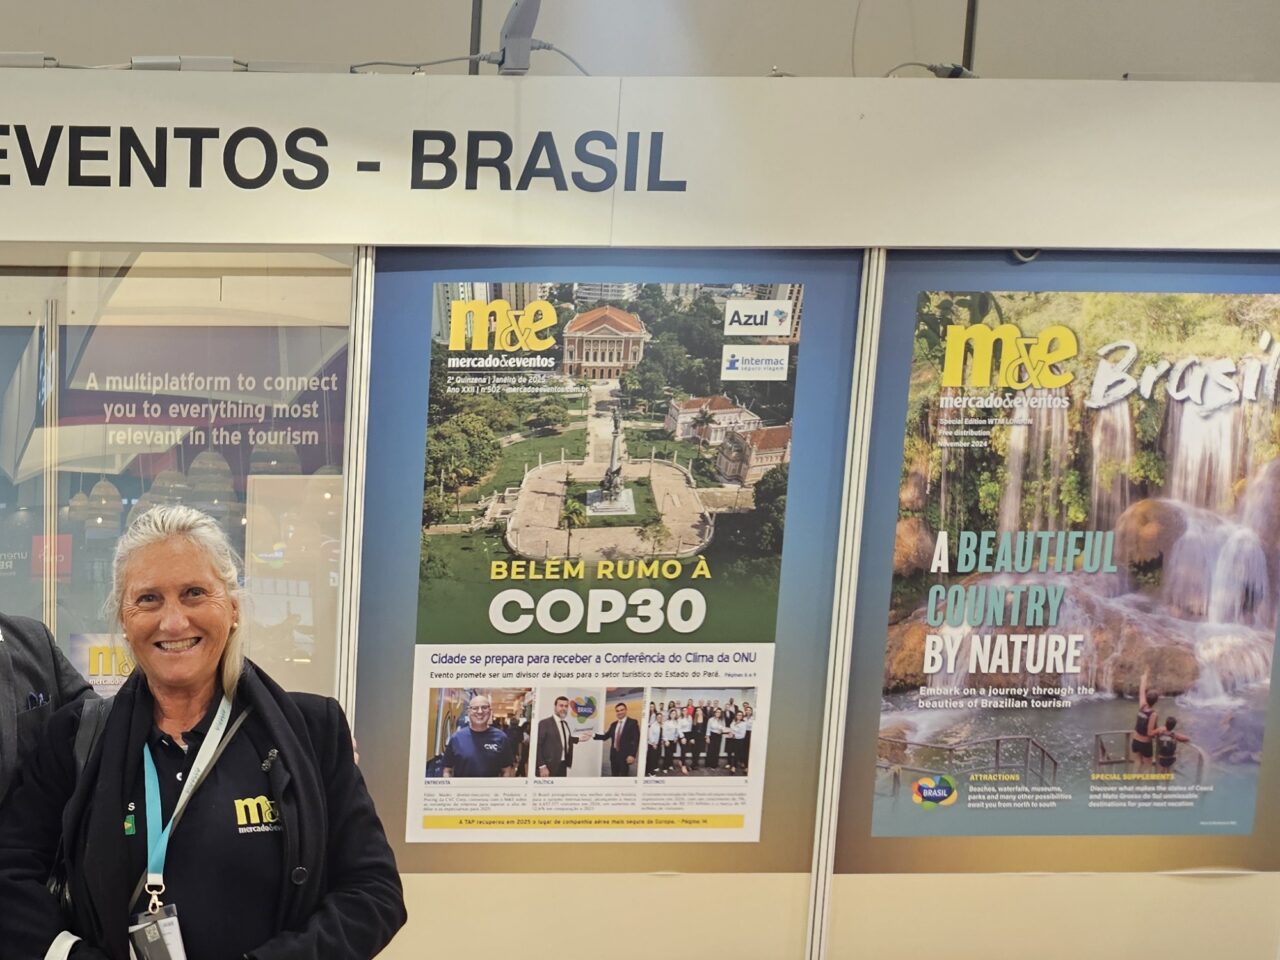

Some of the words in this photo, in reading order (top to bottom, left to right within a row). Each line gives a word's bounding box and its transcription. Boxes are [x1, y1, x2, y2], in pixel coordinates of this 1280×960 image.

[411, 130, 687, 192] BRASIL
[448, 298, 557, 352] m&e
[729, 310, 768, 326] Azul
[448, 354, 555, 368] mercado&eventos
[741, 357, 784, 365] Intermac
[942, 323, 1078, 391] m&e
[86, 373, 98, 390] A
[106, 372, 230, 395] multiplatform
[237, 374, 256, 390] to
[264, 374, 338, 391] connect
[104, 403, 136, 422] you
[144, 401, 162, 417] to
[169, 400, 265, 423] everything
[273, 402, 318, 417] most
[940, 393, 1070, 408] mercado&eventos
[108, 429, 182, 445] relevant
[190, 429, 205, 444] in
[212, 429, 241, 445] the
[248, 429, 318, 445] tourism
[930, 530, 949, 573] A
[957, 530, 1118, 573] BEAUTIFUL
[490, 556, 584, 580] BELÉM
[597, 559, 682, 579] RUMO
[691, 555, 712, 579] À
[488, 588, 707, 634] COP30
[926, 584, 1065, 628] COUNTRY
[431, 653, 466, 664] Cidade
[470, 656, 481, 664] se
[484, 655, 524, 666] prepara
[527, 655, 549, 666] para
[553, 654, 592, 664] receber
[595, 655, 601, 663] a
[605, 652, 665, 663] Conferência
[669, 653, 682, 663] do
[685, 652, 714, 663] Clima
[717, 653, 729, 662] da
[733, 652, 757, 663] ONU
[923, 634, 963, 675] BY
[969, 634, 1084, 674] NATURE
[456, 672, 486, 680] promete
[918, 699, 964, 708] beauties
[968, 699, 978, 708] of
[981, 698, 1028, 708] Brazilian
[1032, 699, 1071, 708] tourism
[920, 687, 960, 695] Embark
[963, 687, 976, 695] on
[988, 686, 1028, 697] journey
[1032, 687, 1073, 697] through
[1078, 687, 1095, 695] the
[923, 789, 948, 797] BRASIL
[234, 796, 280, 825] m&
